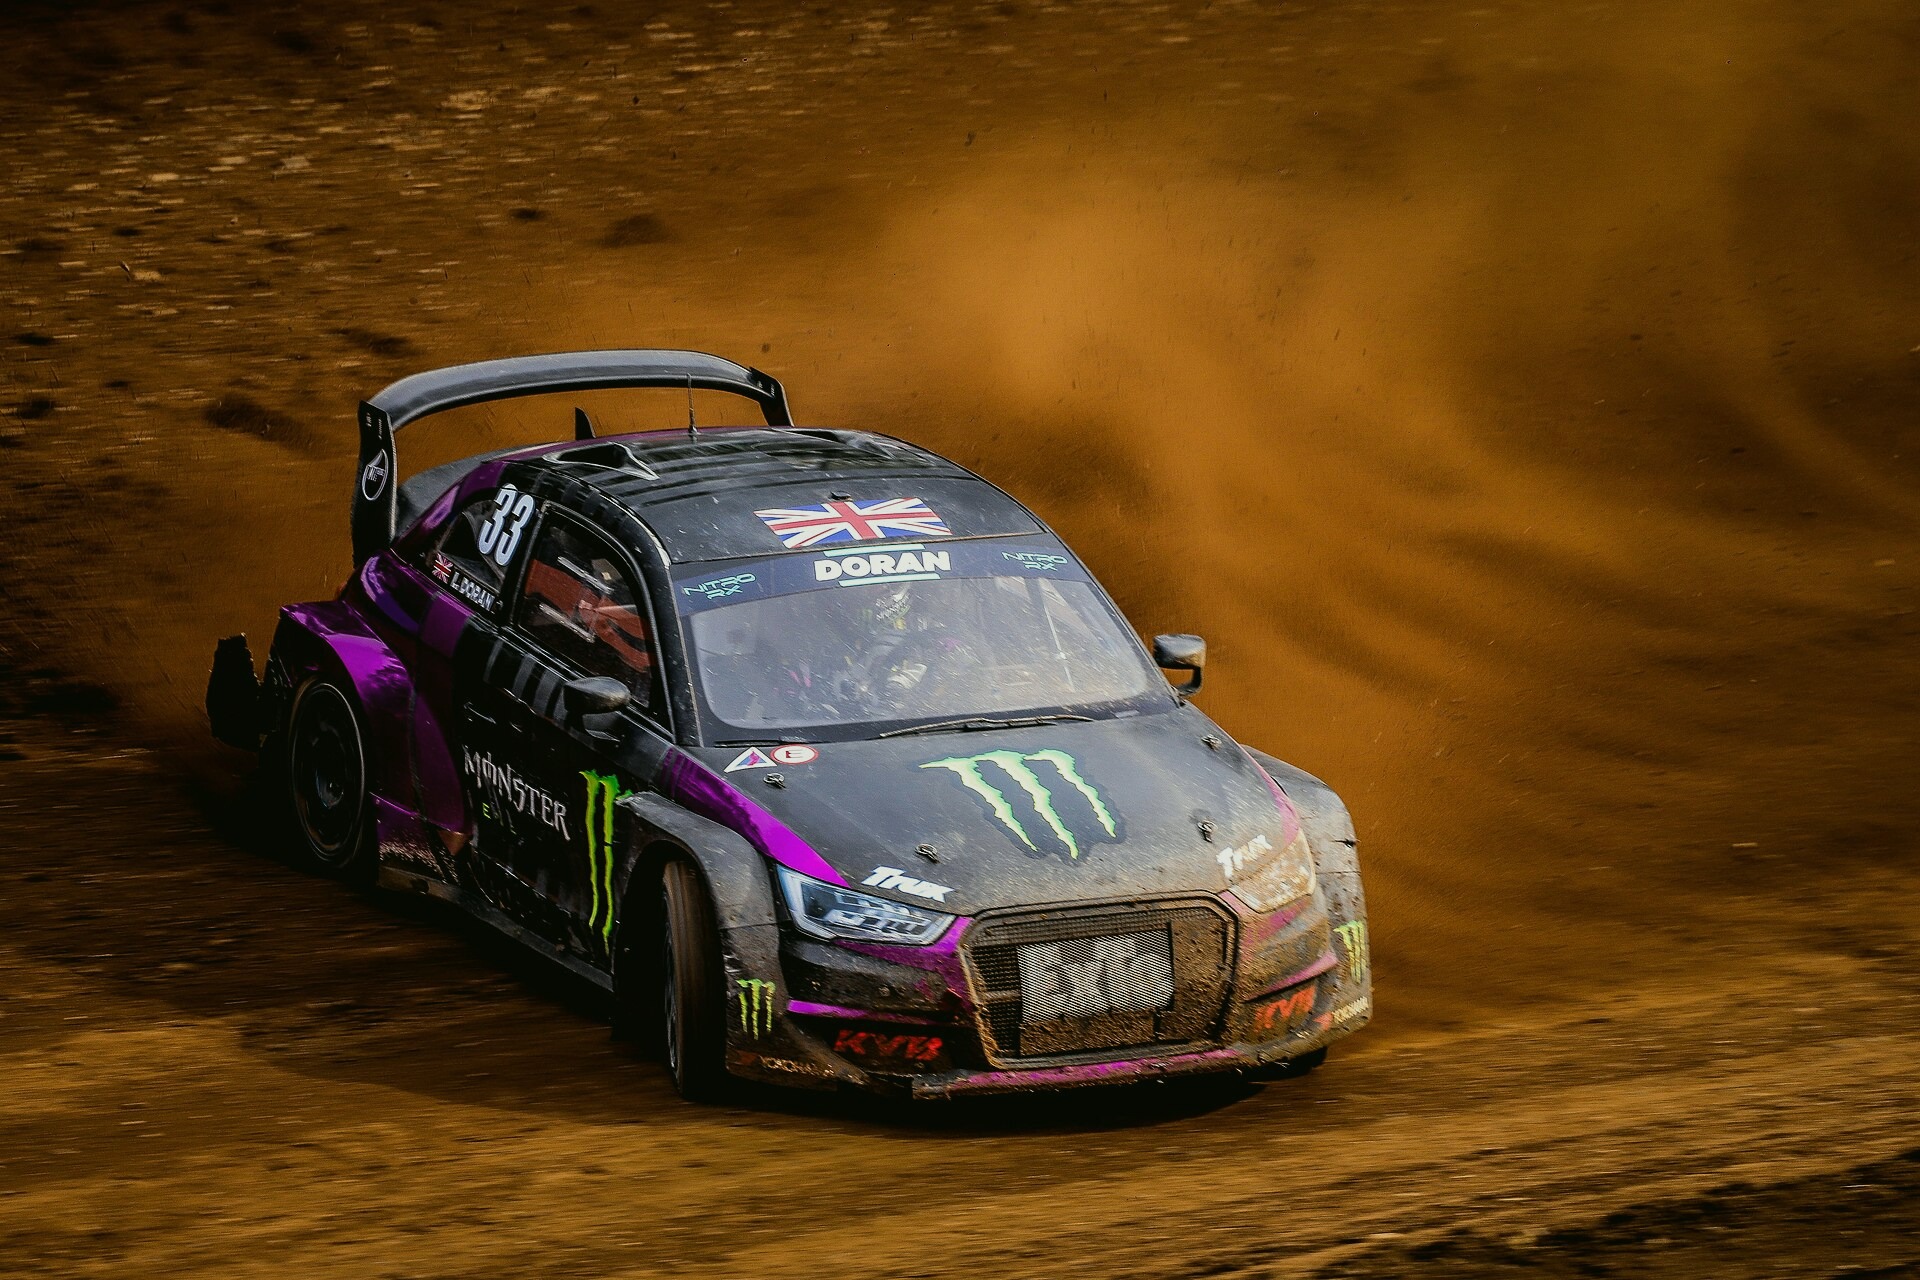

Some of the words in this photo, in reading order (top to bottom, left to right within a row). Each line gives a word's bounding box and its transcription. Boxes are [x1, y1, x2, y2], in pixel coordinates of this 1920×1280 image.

[477, 482, 536, 567] 33
[813, 550, 951, 582] DORAN
[1001, 551, 1068, 564] NITRO
[683, 573, 756, 596] NITRO
[463, 745, 571, 841] MONSTER
